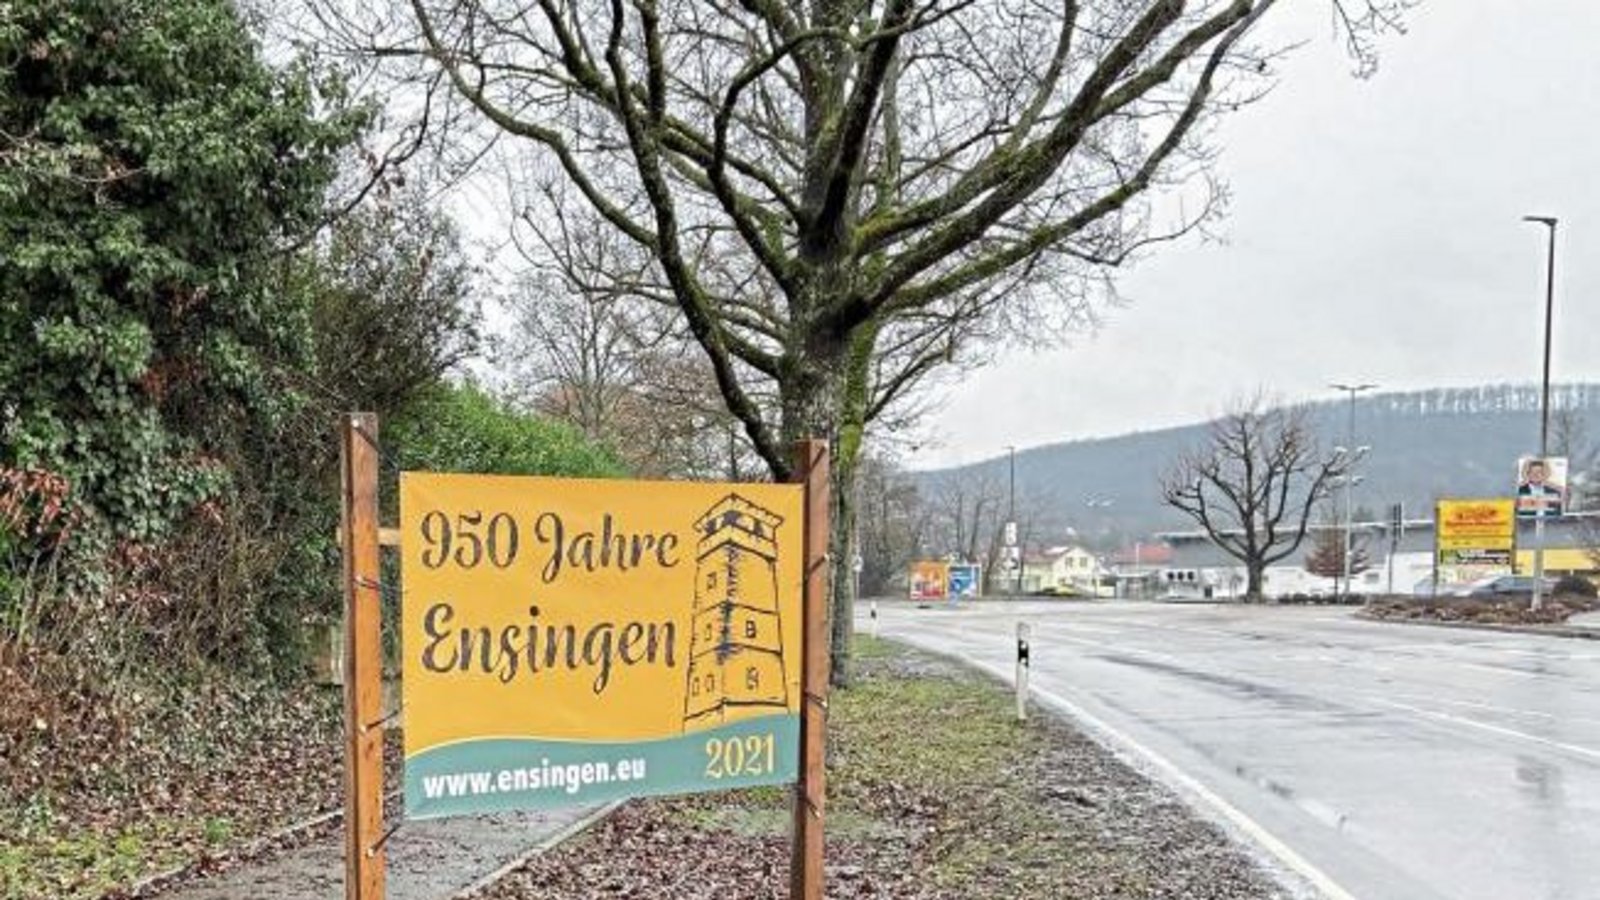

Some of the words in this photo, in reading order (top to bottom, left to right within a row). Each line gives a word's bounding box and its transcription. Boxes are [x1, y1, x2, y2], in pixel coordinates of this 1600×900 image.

[421, 509, 519, 570] 950
[534, 512, 680, 584] Jahre
[421, 602, 676, 694] Ensingen
[423, 757, 647, 799] www.ensingen.eu
[705, 732, 774, 780] 2021
